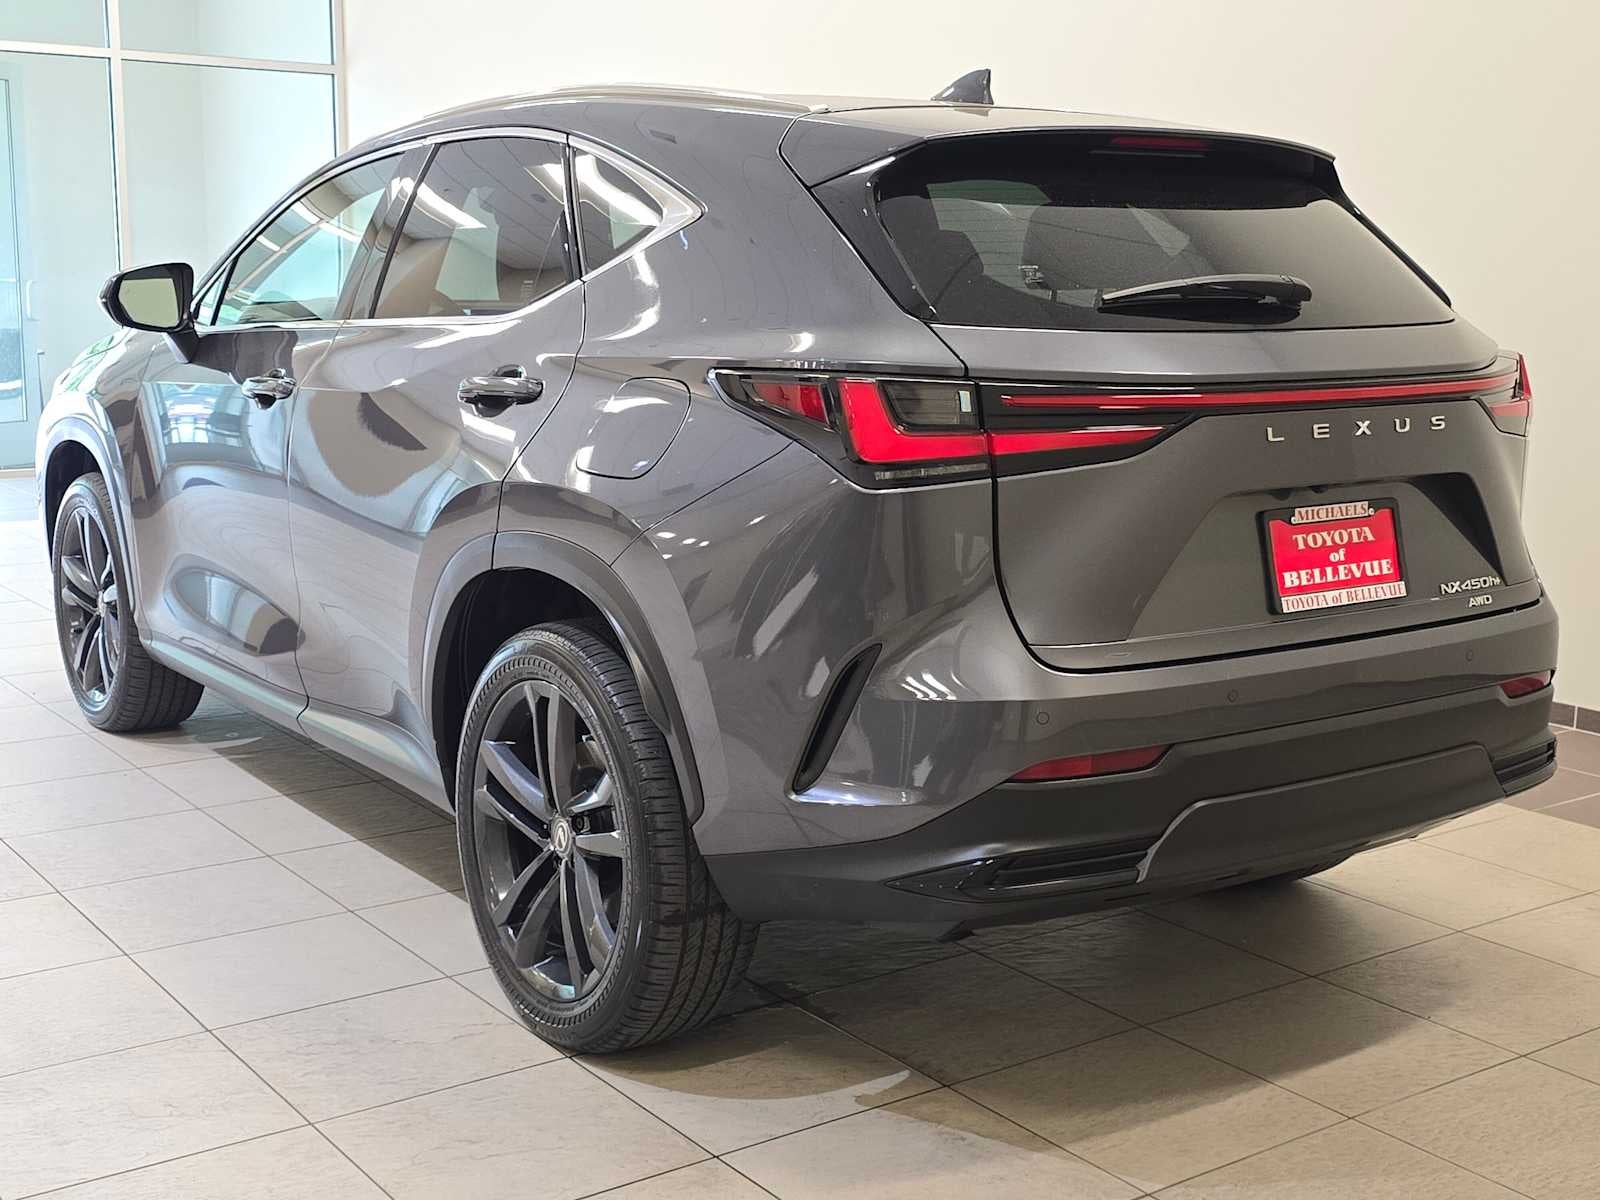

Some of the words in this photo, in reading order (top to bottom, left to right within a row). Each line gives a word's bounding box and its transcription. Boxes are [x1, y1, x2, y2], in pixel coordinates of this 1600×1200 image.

[1267, 416, 1446, 442] LEXUS
[1297, 503, 1367, 521] MICHAELS
[1293, 526, 1375, 550] TOYOTA
[1329, 548, 1346, 562] of
[1282, 559, 1394, 588] BELLEVUE
[1284, 594, 1329, 611] TOYOTA
[1332, 592, 1343, 604] of
[1346, 583, 1405, 602] BELLEVUE
[1468, 594, 1493, 608] AWD
